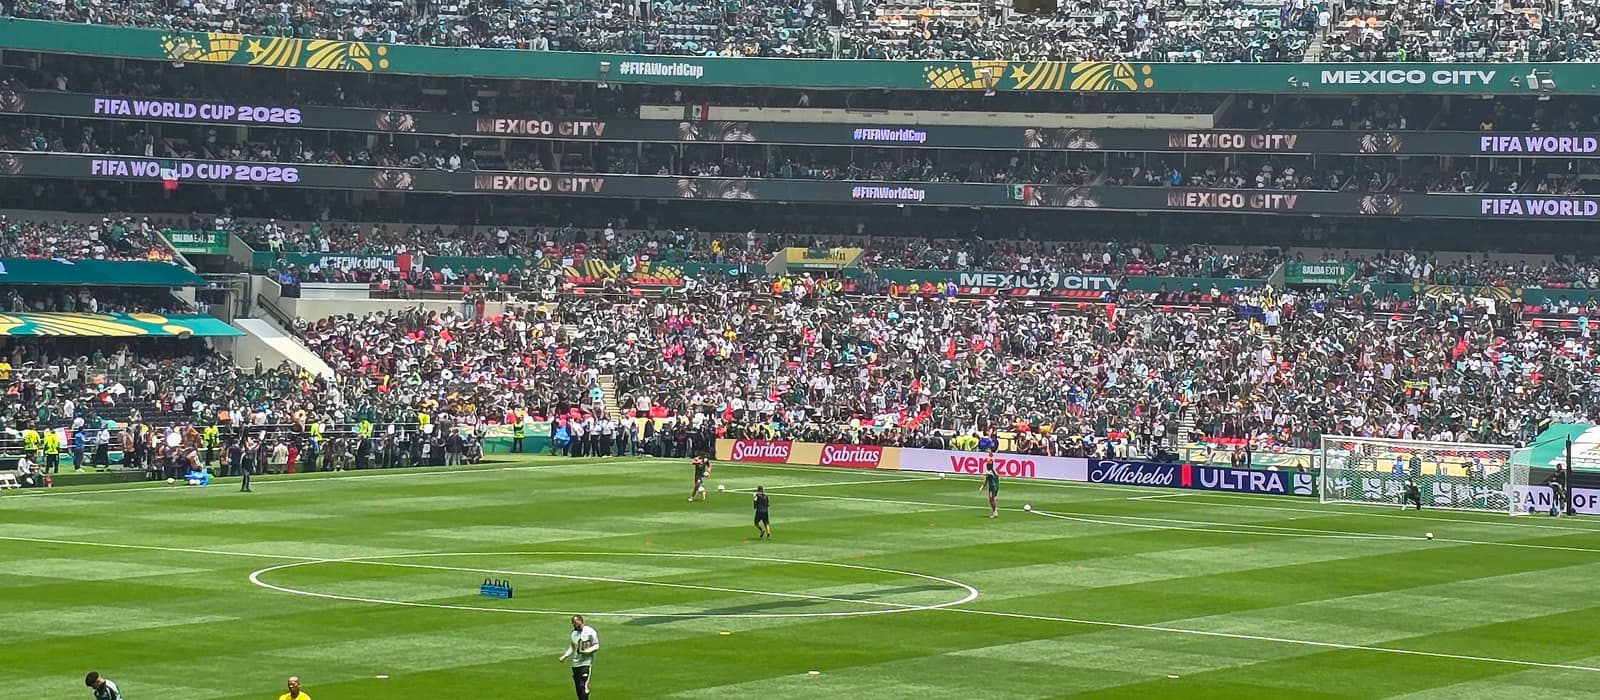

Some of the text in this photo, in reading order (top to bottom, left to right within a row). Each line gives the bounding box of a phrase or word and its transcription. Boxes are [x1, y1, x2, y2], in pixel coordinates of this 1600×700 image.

[620, 62, 703, 79] #FIFAWorldCup
[1321, 70, 1496, 84] MEXICO CITY
[94, 98, 301, 124] FIFA WORLD CUP 2026
[476, 119, 606, 136] MEXICO CITY
[853, 128, 927, 143] #FIFAWorldCup
[1168, 133, 1297, 149] MEXICO CITY
[1481, 136, 1597, 152] FIFA WORLD
[92, 159, 299, 183] FIFA WOD CUP 2026
[474, 176, 604, 192] MEXICO CITY
[852, 186, 925, 201] #FIFAWorldCup
[1167, 192, 1298, 209] MEXICO CITY
[1481, 199, 1598, 216] FIFA WORLD
[1303, 265, 1324, 275] SALIDA
[1325, 266, 1339, 276] EXIT
[1064, 276, 1119, 290] CITY
[733, 441, 788, 460] Sabritas
[822, 446, 879, 465] Sabritas
[951, 456, 1035, 478] verzon
[1091, 461, 1284, 492] Michelob ULTRA
[1573, 494, 1598, 509] OF
